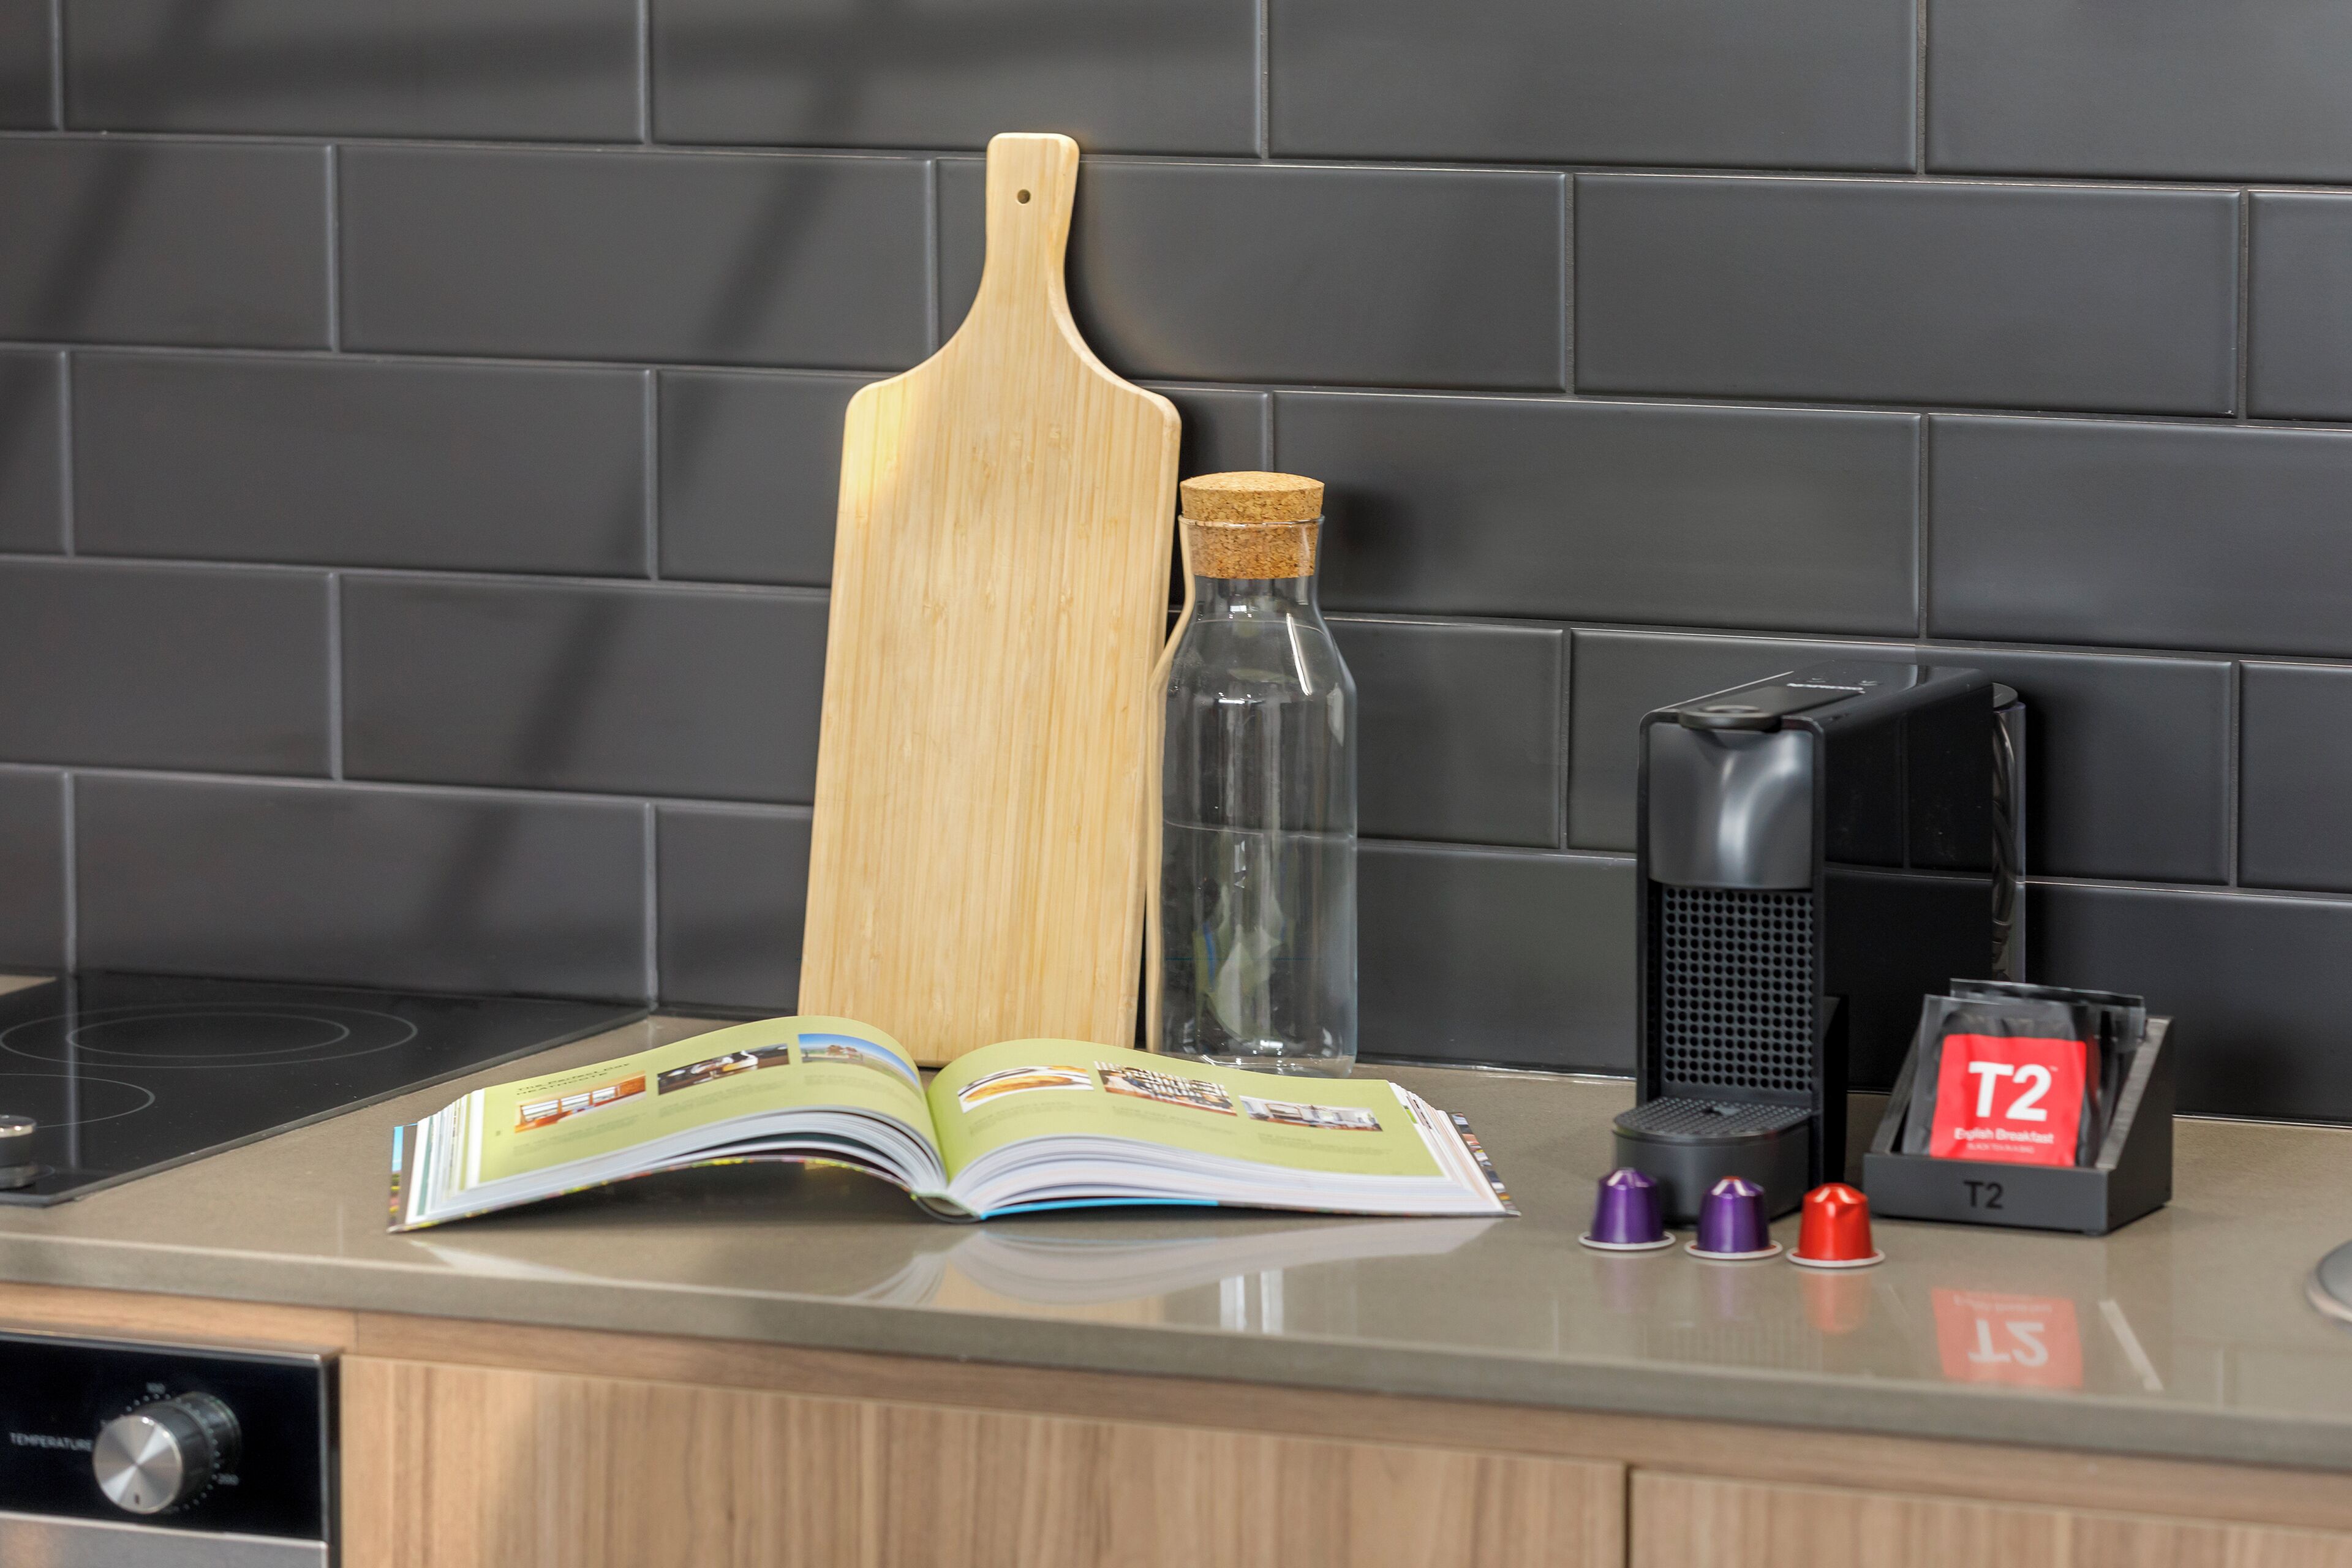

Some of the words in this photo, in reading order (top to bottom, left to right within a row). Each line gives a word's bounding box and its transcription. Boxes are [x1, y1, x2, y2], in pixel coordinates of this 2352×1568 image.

[1969, 1061, 2051, 1121] T2
[1954, 1128, 1994, 1140] English
[1995, 1128, 2054, 1144] Breakfast
[1964, 1180, 2003, 1209] T2
[10, 1432, 93, 1452] TEMPERATURE
